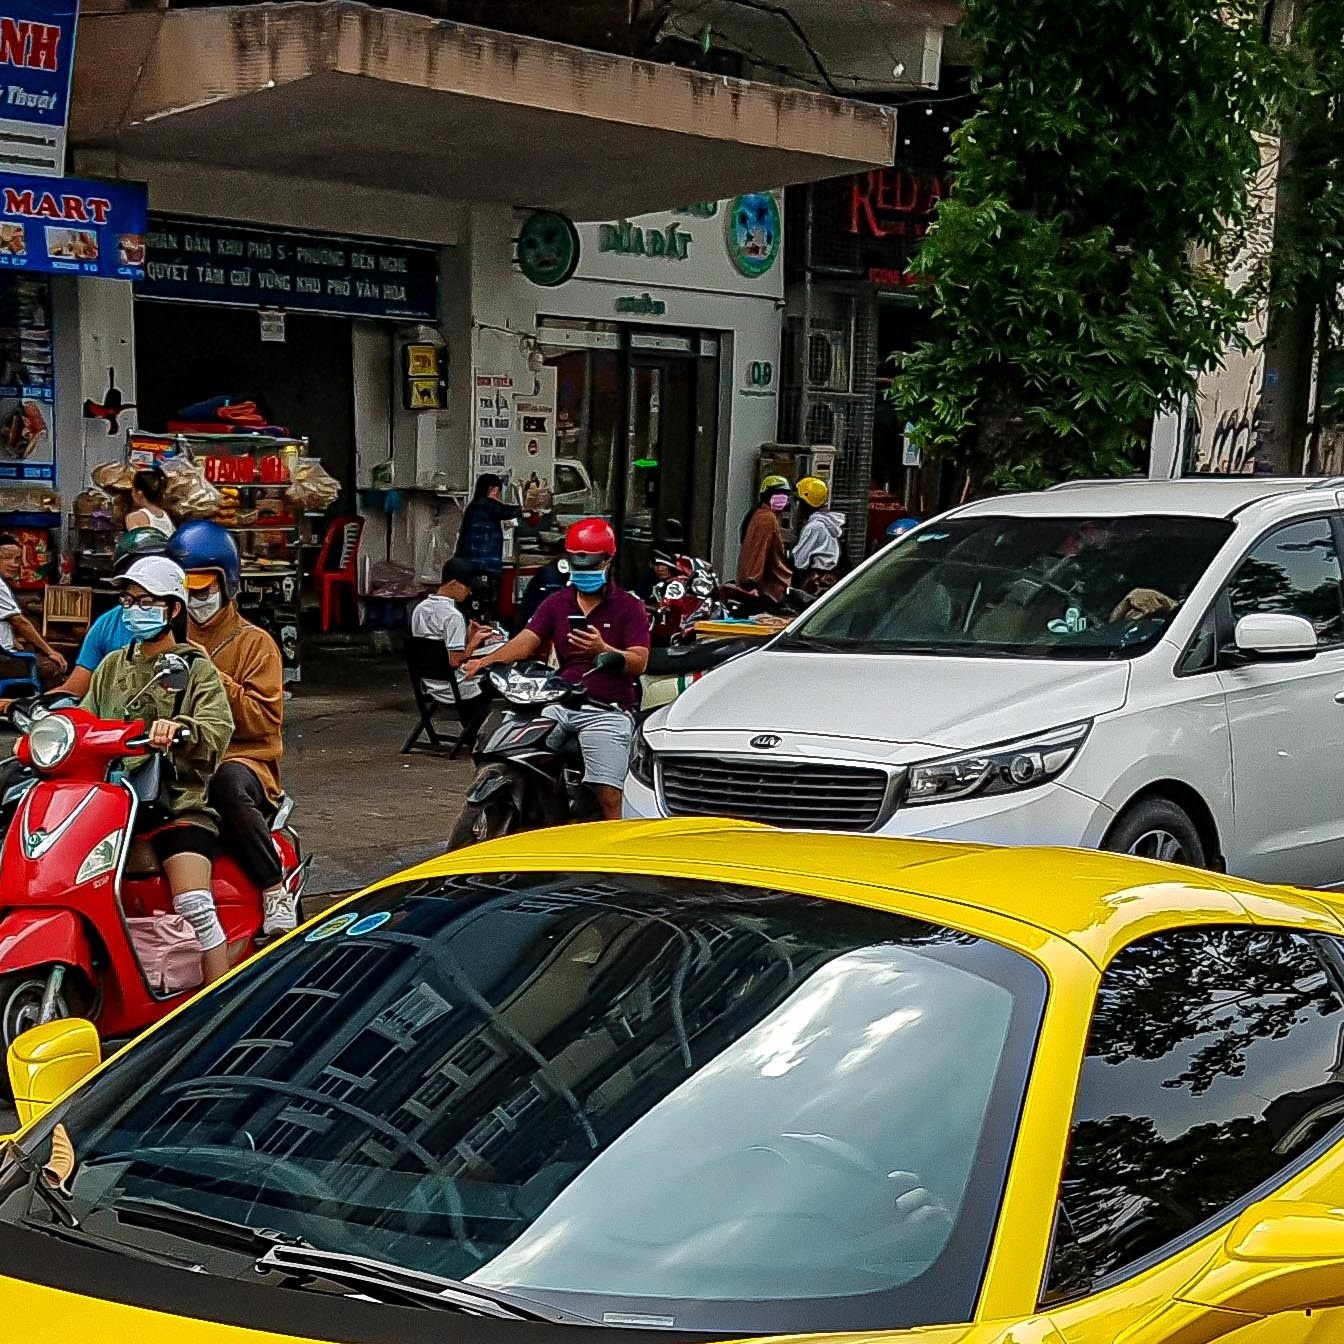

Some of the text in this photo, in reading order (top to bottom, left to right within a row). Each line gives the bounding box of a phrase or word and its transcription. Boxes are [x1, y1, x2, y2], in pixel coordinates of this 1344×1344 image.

[8, 85, 57, 114] Thuật
[3, 188, 111, 225] MART
[217, 239, 243, 256] KHU
[147, 257, 188, 281] QUYẾT
[296, 276, 321, 294] KHU
[327, 275, 351, 296] PHỐ
